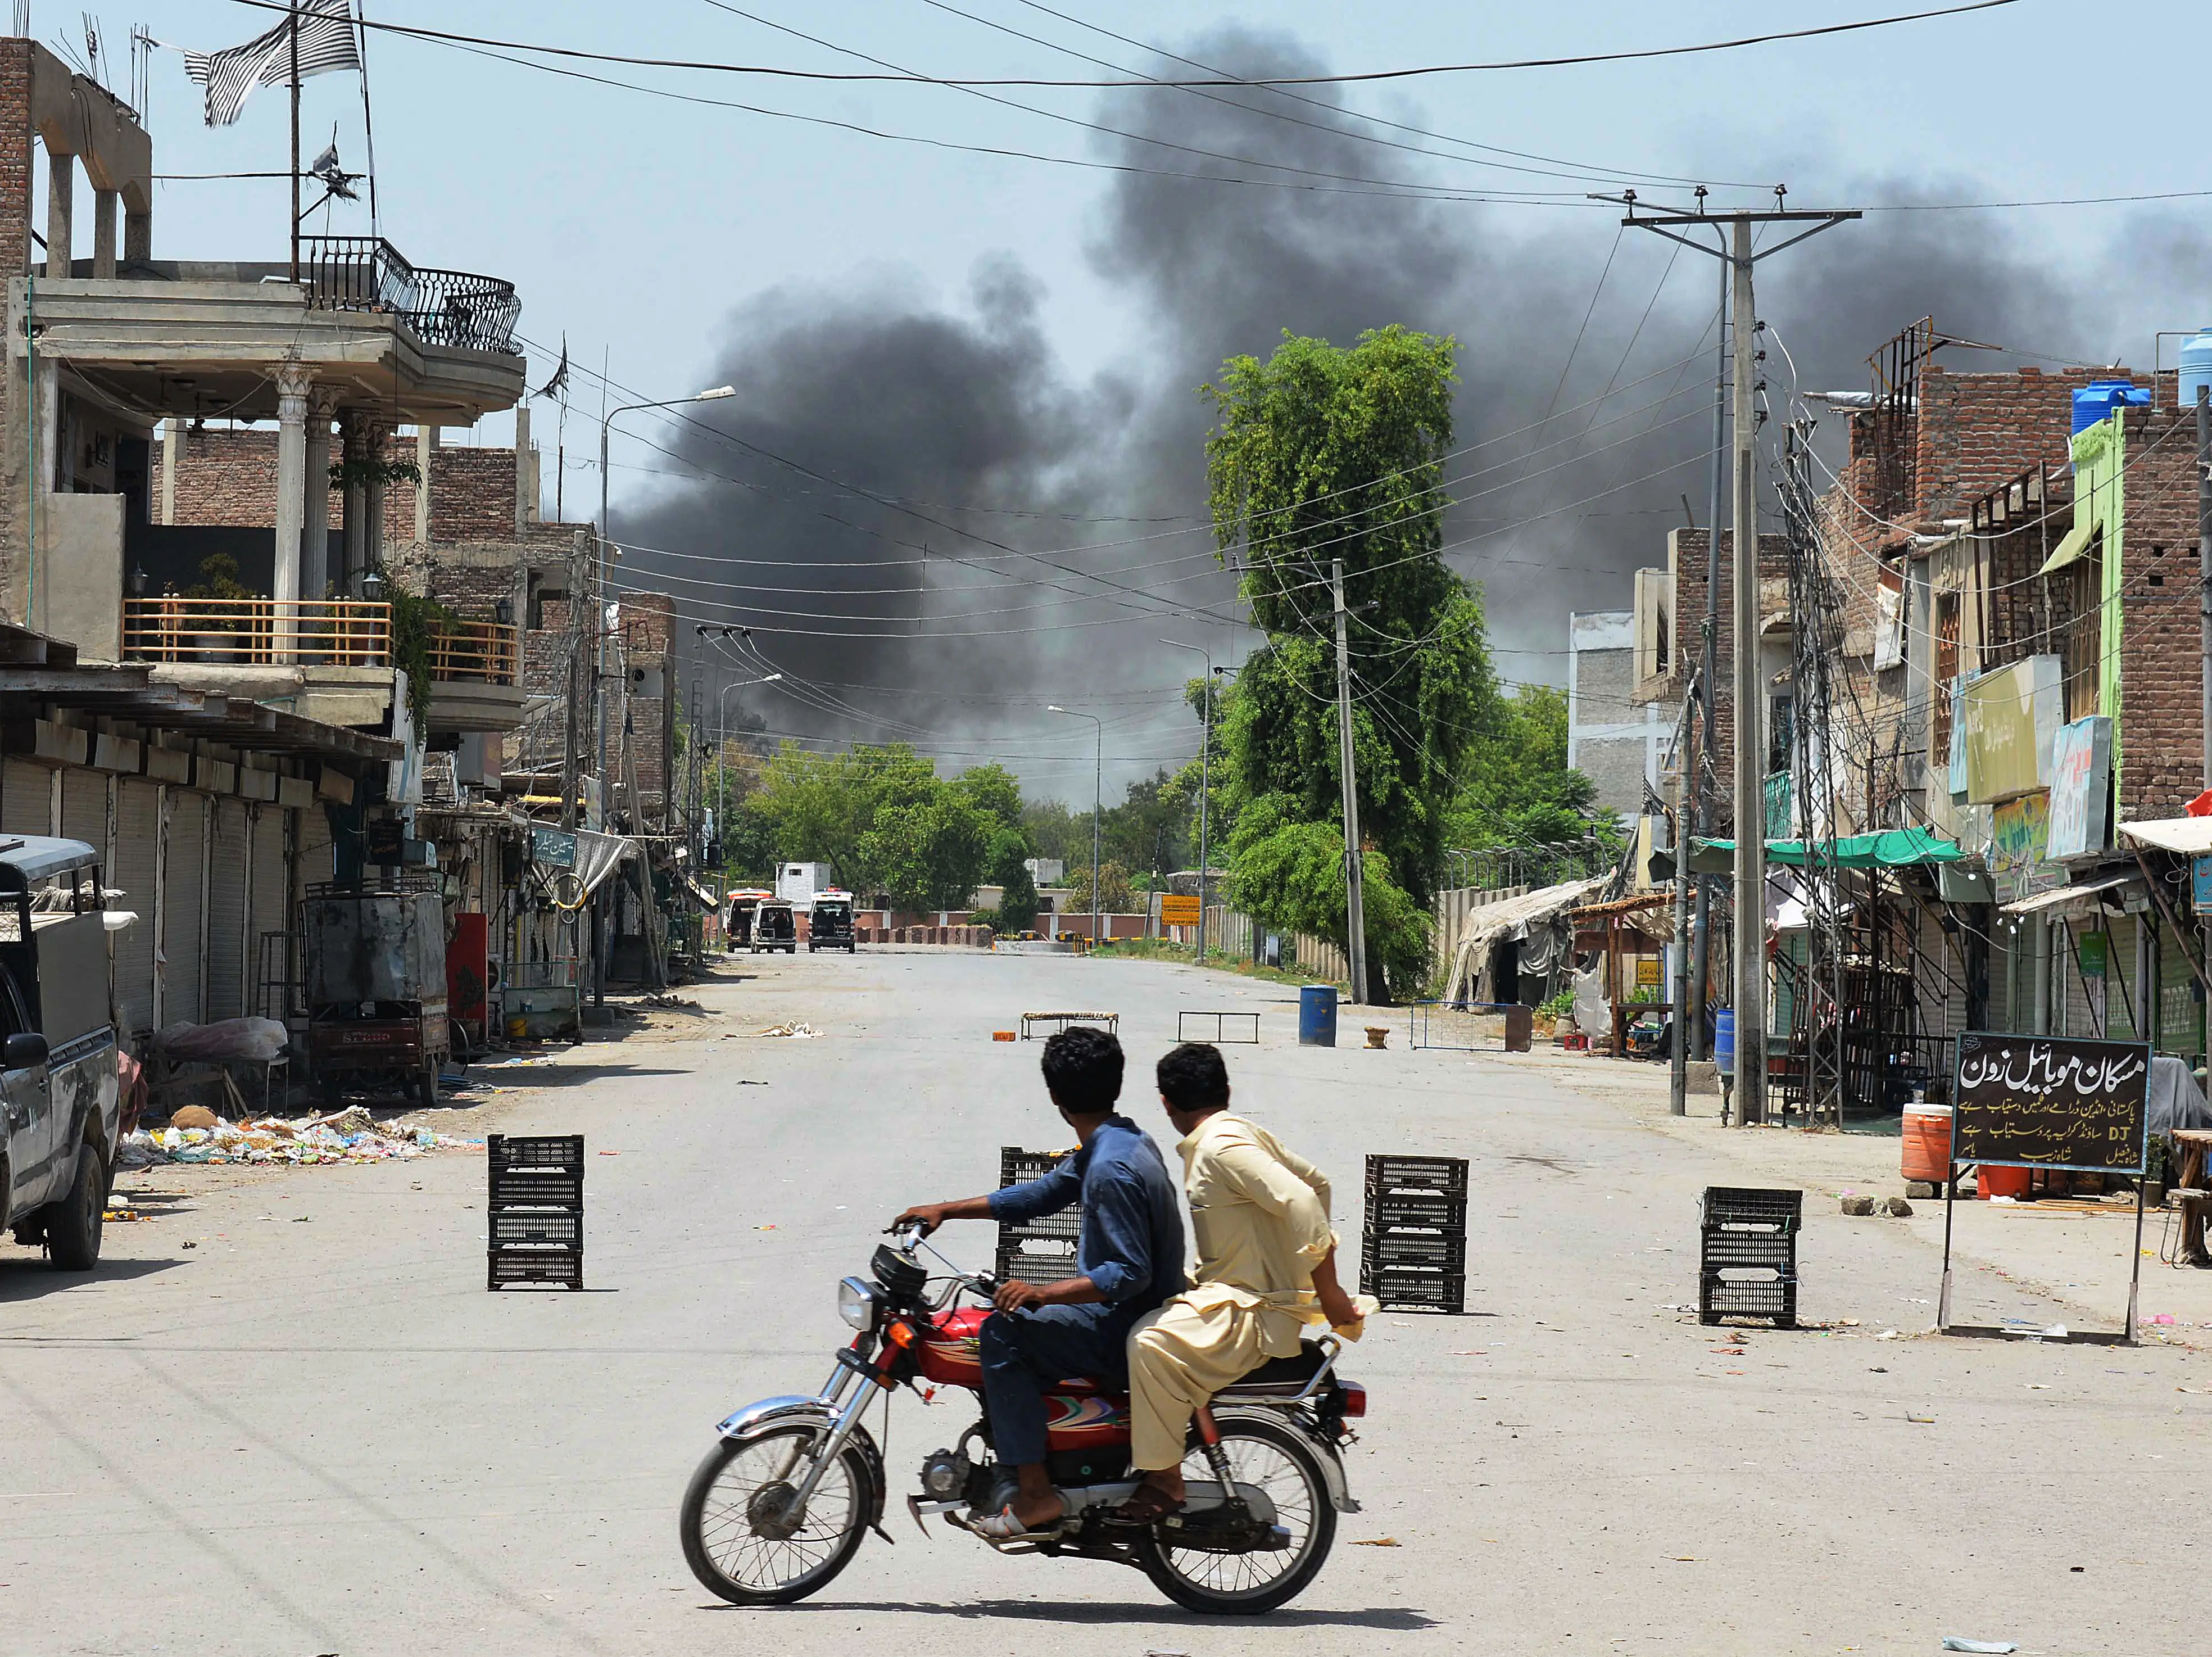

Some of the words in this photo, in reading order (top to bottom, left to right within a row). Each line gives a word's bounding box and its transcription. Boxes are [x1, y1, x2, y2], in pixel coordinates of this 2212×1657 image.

[1960, 1049, 2011, 1089] زون
[2075, 1053, 2145, 1094] مسکان
[1986, 1098, 2021, 1115] دستیاب
[2107, 1098, 2138, 1124] پاکستانی
[2109, 1126, 2131, 1140] DJ
